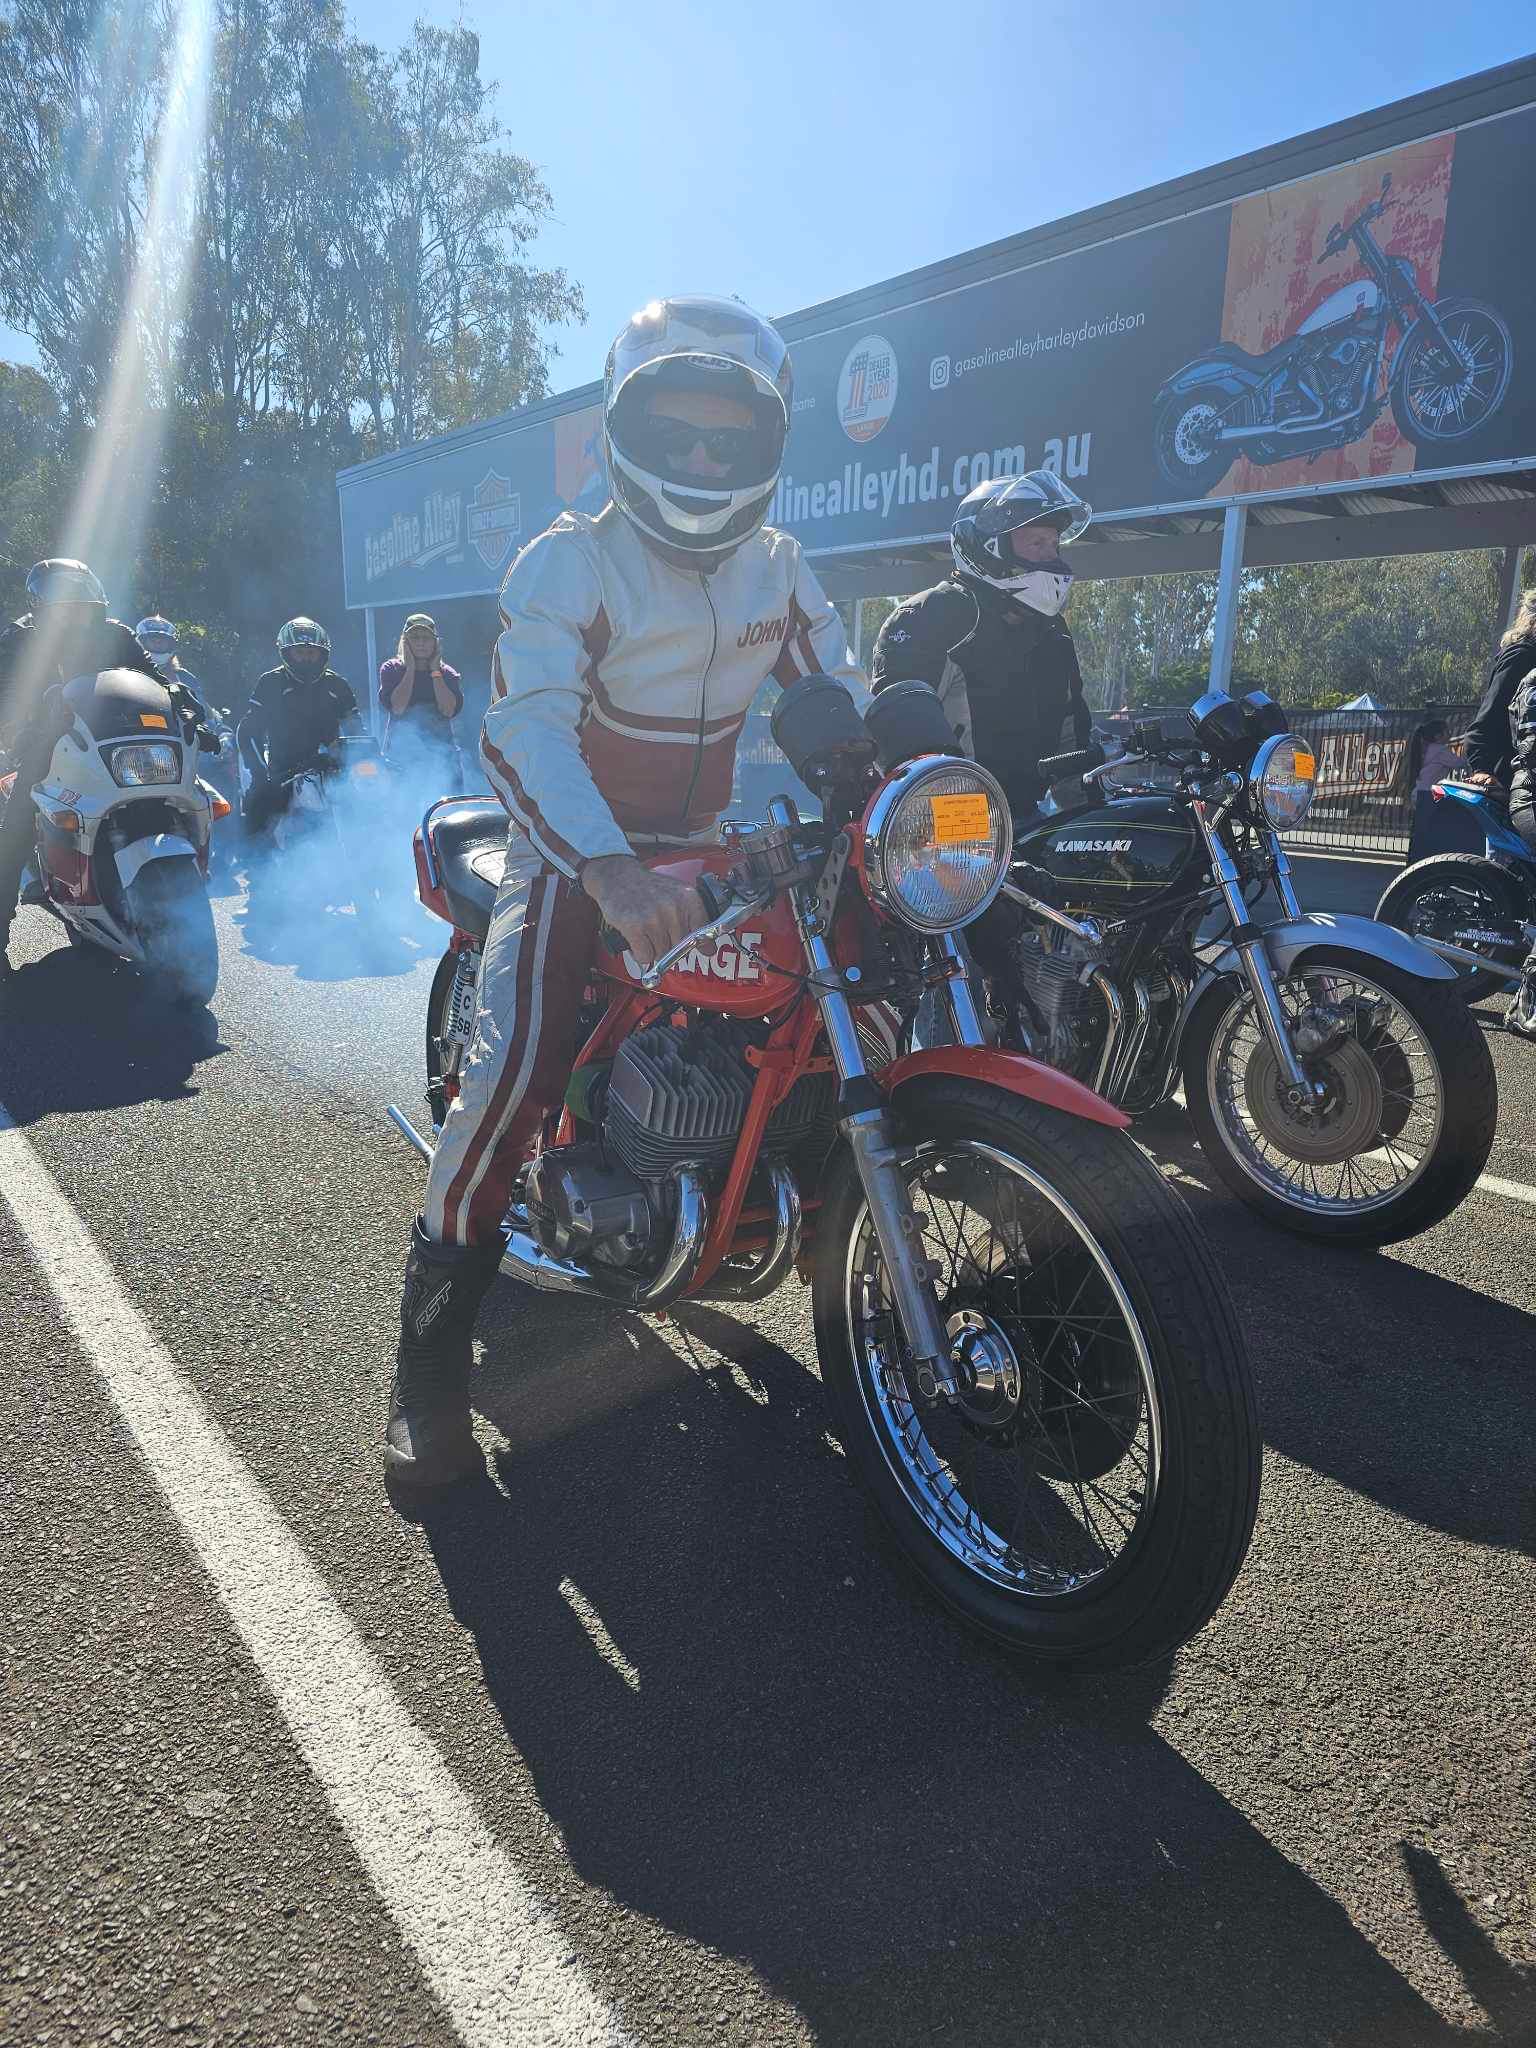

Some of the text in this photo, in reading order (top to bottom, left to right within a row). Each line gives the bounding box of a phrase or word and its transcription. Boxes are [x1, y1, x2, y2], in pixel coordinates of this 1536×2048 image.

[954, 312, 1145, 377] gasolinealleyharleydavidson
[737, 616, 788, 649] JOHN
[1318, 734, 1408, 792] Alley
[1055, 839, 1133, 853] KAWASAKI
